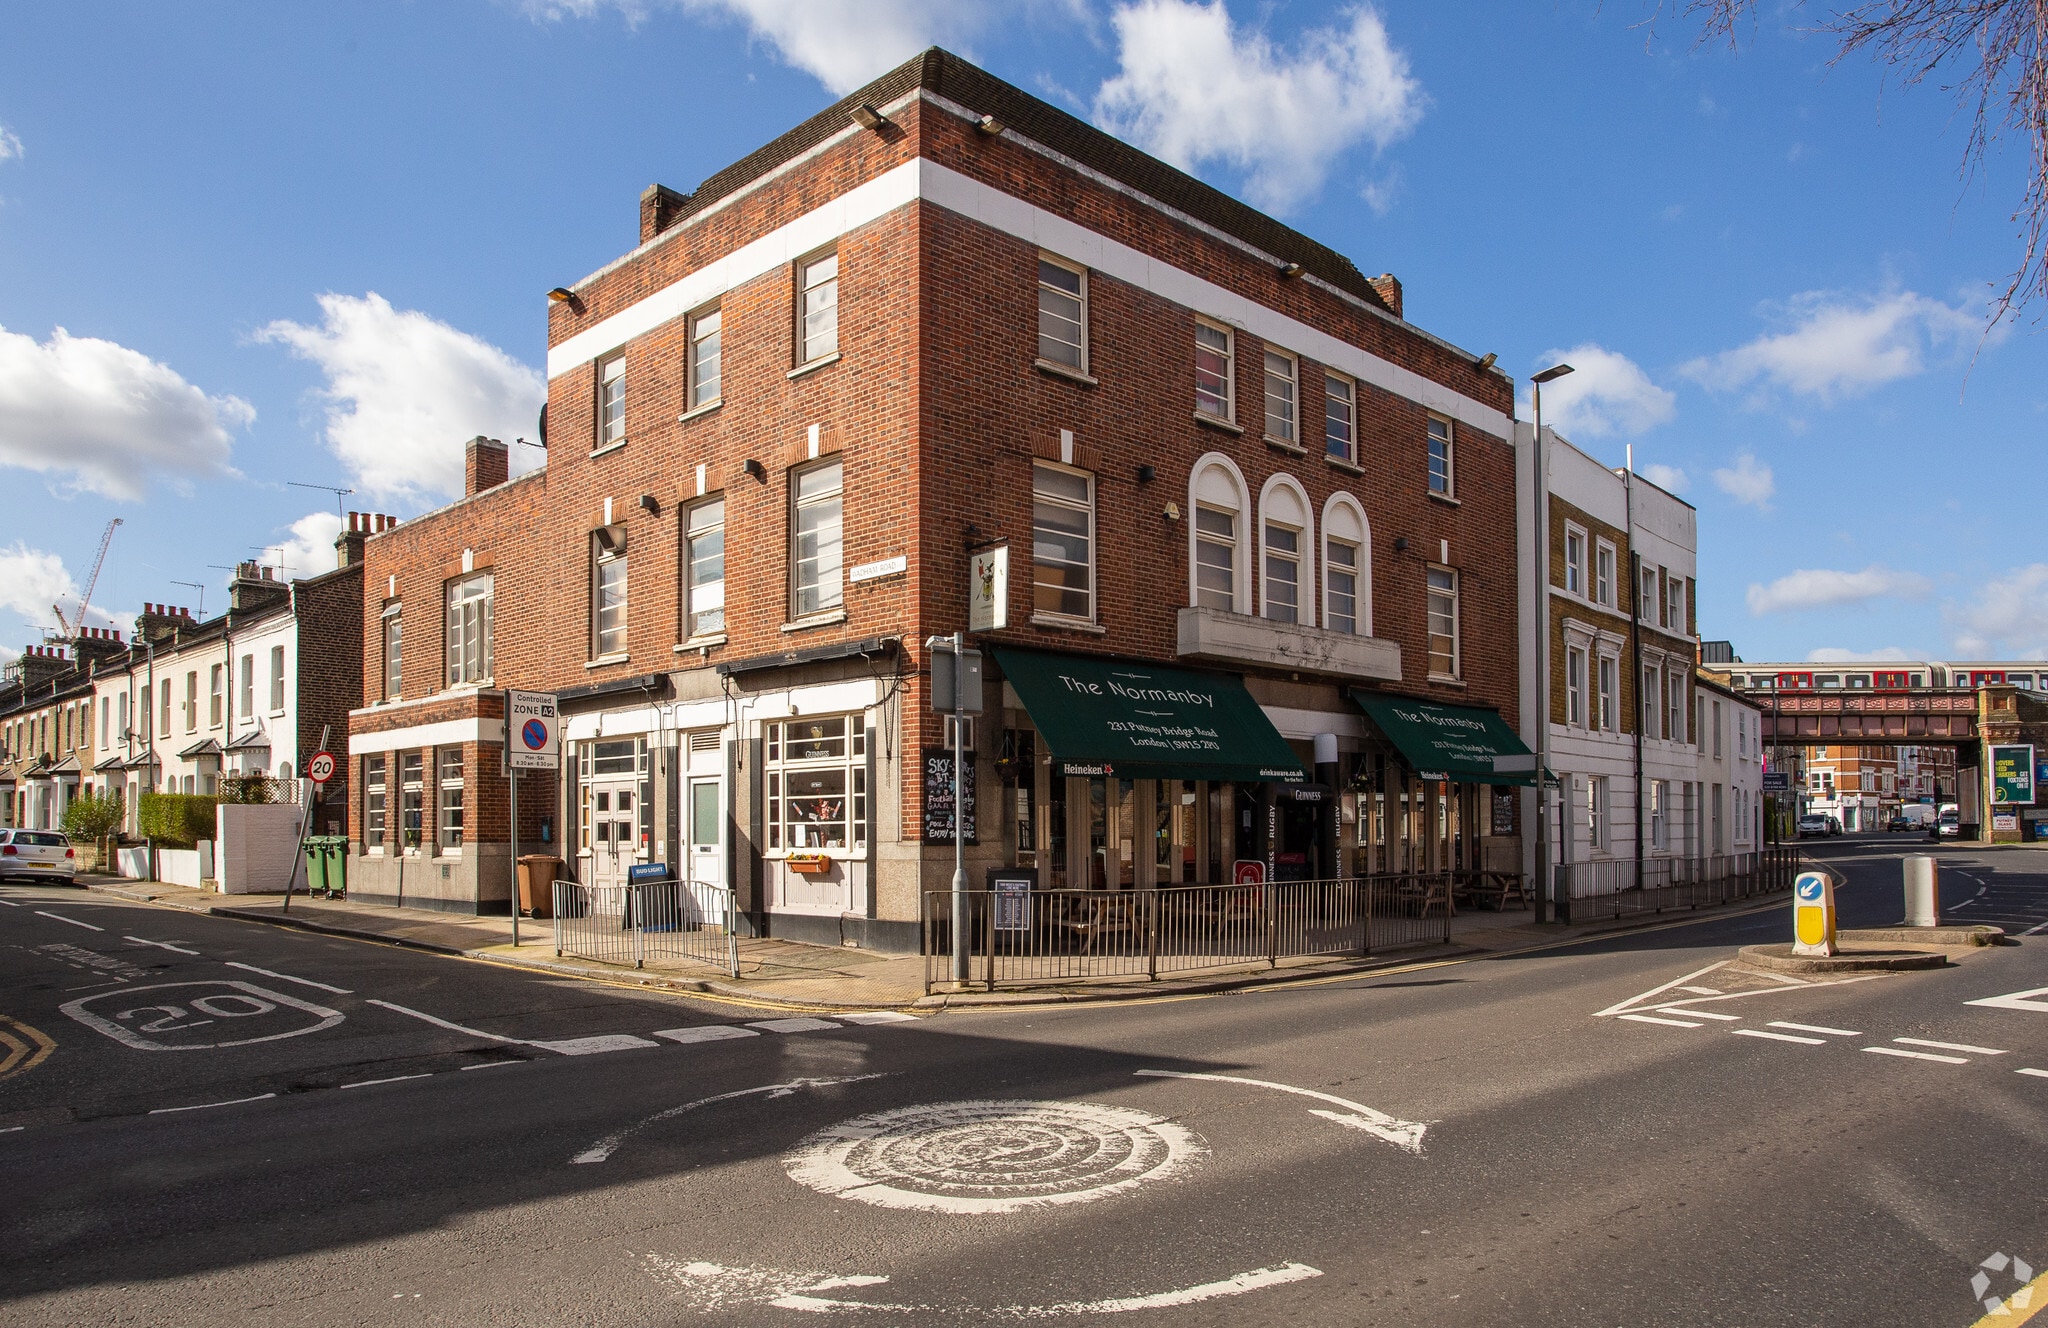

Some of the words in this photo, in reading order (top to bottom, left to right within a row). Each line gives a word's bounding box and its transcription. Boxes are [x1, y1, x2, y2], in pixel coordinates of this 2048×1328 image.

[852, 565, 878, 578] WADHAM
[880, 561, 897, 572] ROAD
[1058, 675, 1103, 695] The
[1107, 680, 1213, 708] Normanby
[517, 694, 552, 704] Controlled
[514, 705, 539, 714] ZONE
[542, 707, 554, 717] A2
[1392, 708, 1421, 723] The
[1420, 712, 1487, 733] Normanby
[1107, 721, 1127, 731] 231
[1127, 721, 1162, 736] Putney
[1161, 726, 1195, 738] Bridge
[1195, 726, 1219, 738] Road
[1129, 736, 1168, 748] London
[1174, 740, 1201, 750] SW15
[1200, 740, 1220, 750] 2PU
[805, 750, 830, 758] GUINNESS
[313, 761, 331, 774] 20
[1064, 763, 1103, 775] Heineken
[1259, 768, 1304, 777] drinkaware.co.uk
[1420, 771, 1444, 781] Heineken
[2007, 776, 2029, 784] FOXTONS
[1295, 789, 1321, 801] GUINNESS
[1268, 805, 1276, 838] RUGBY
[929, 829, 949, 838] ENJOY
[116, 995, 276, 1033] 20
